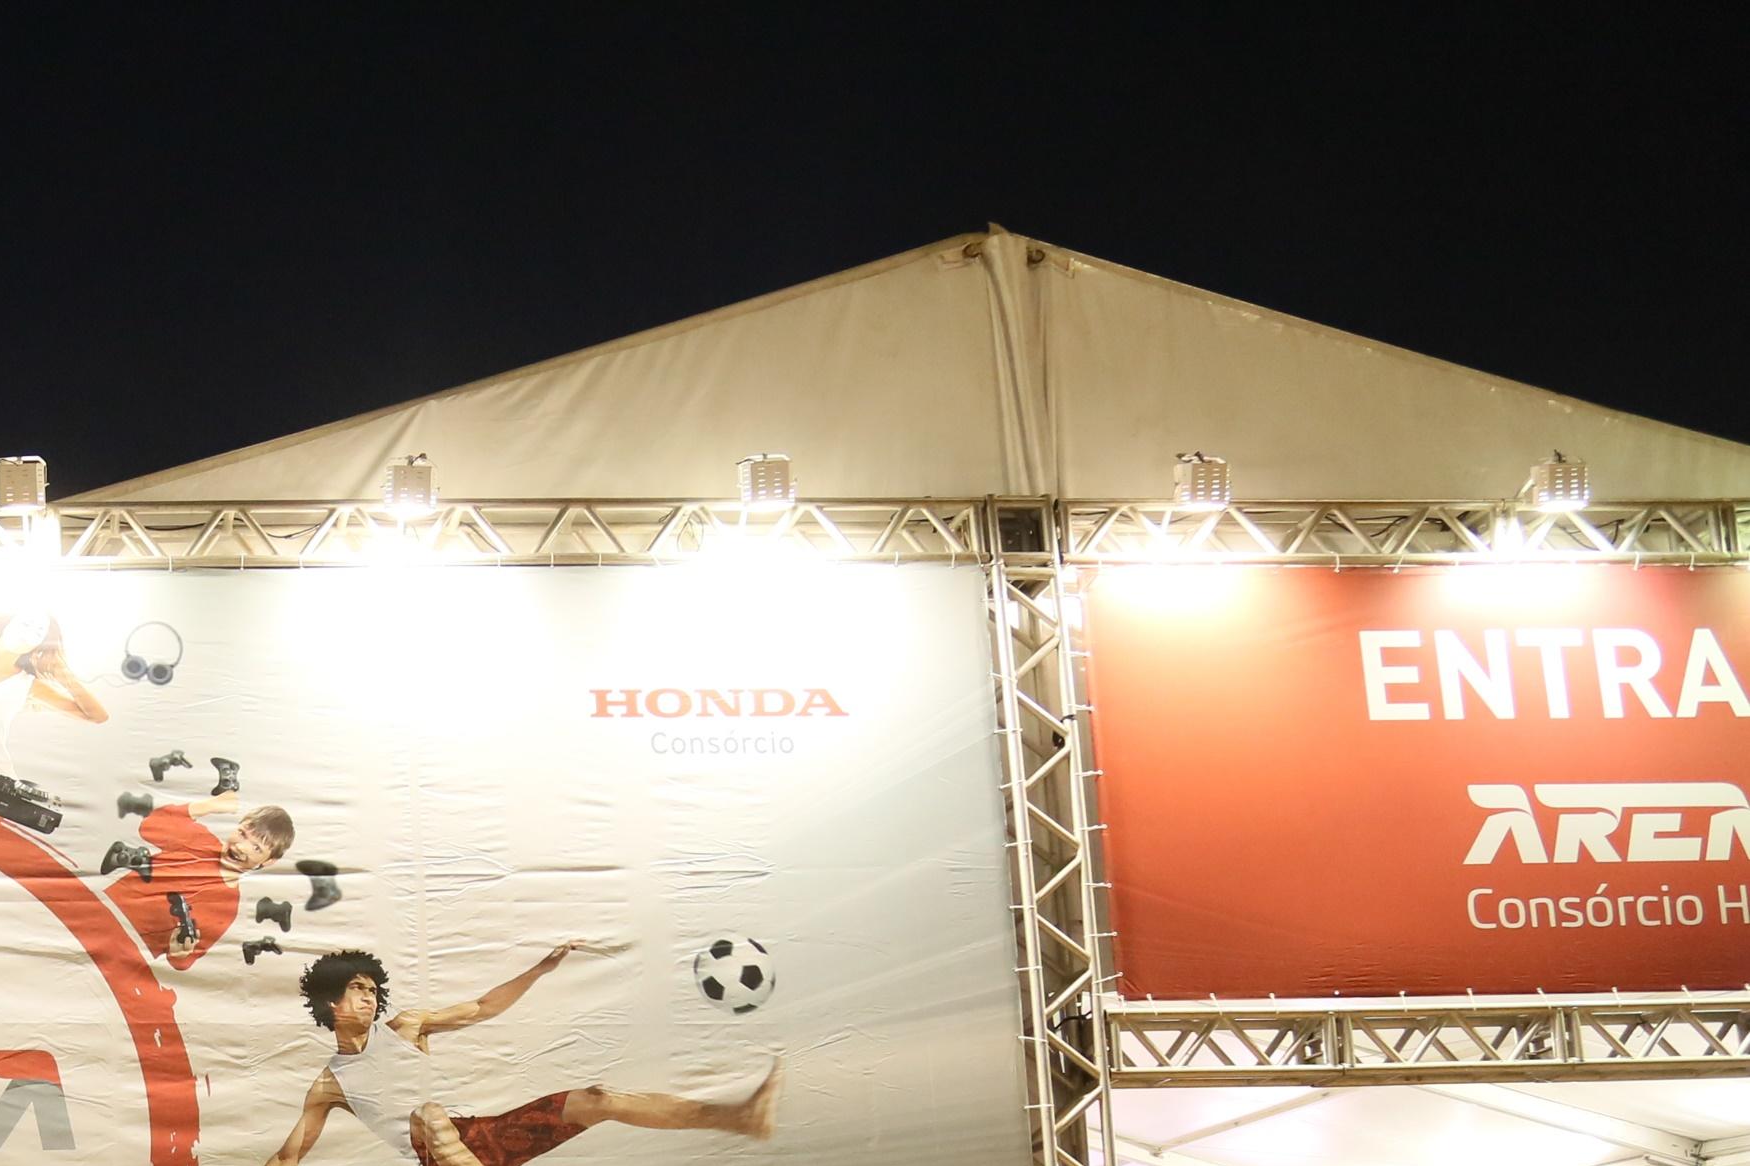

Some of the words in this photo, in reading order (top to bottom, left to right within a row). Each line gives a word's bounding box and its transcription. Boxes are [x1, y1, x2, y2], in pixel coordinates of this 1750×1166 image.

[588, 688, 850, 718] HONDA
[650, 729, 795, 754] Consórcio
[1467, 883, 1704, 930] Consórcio
